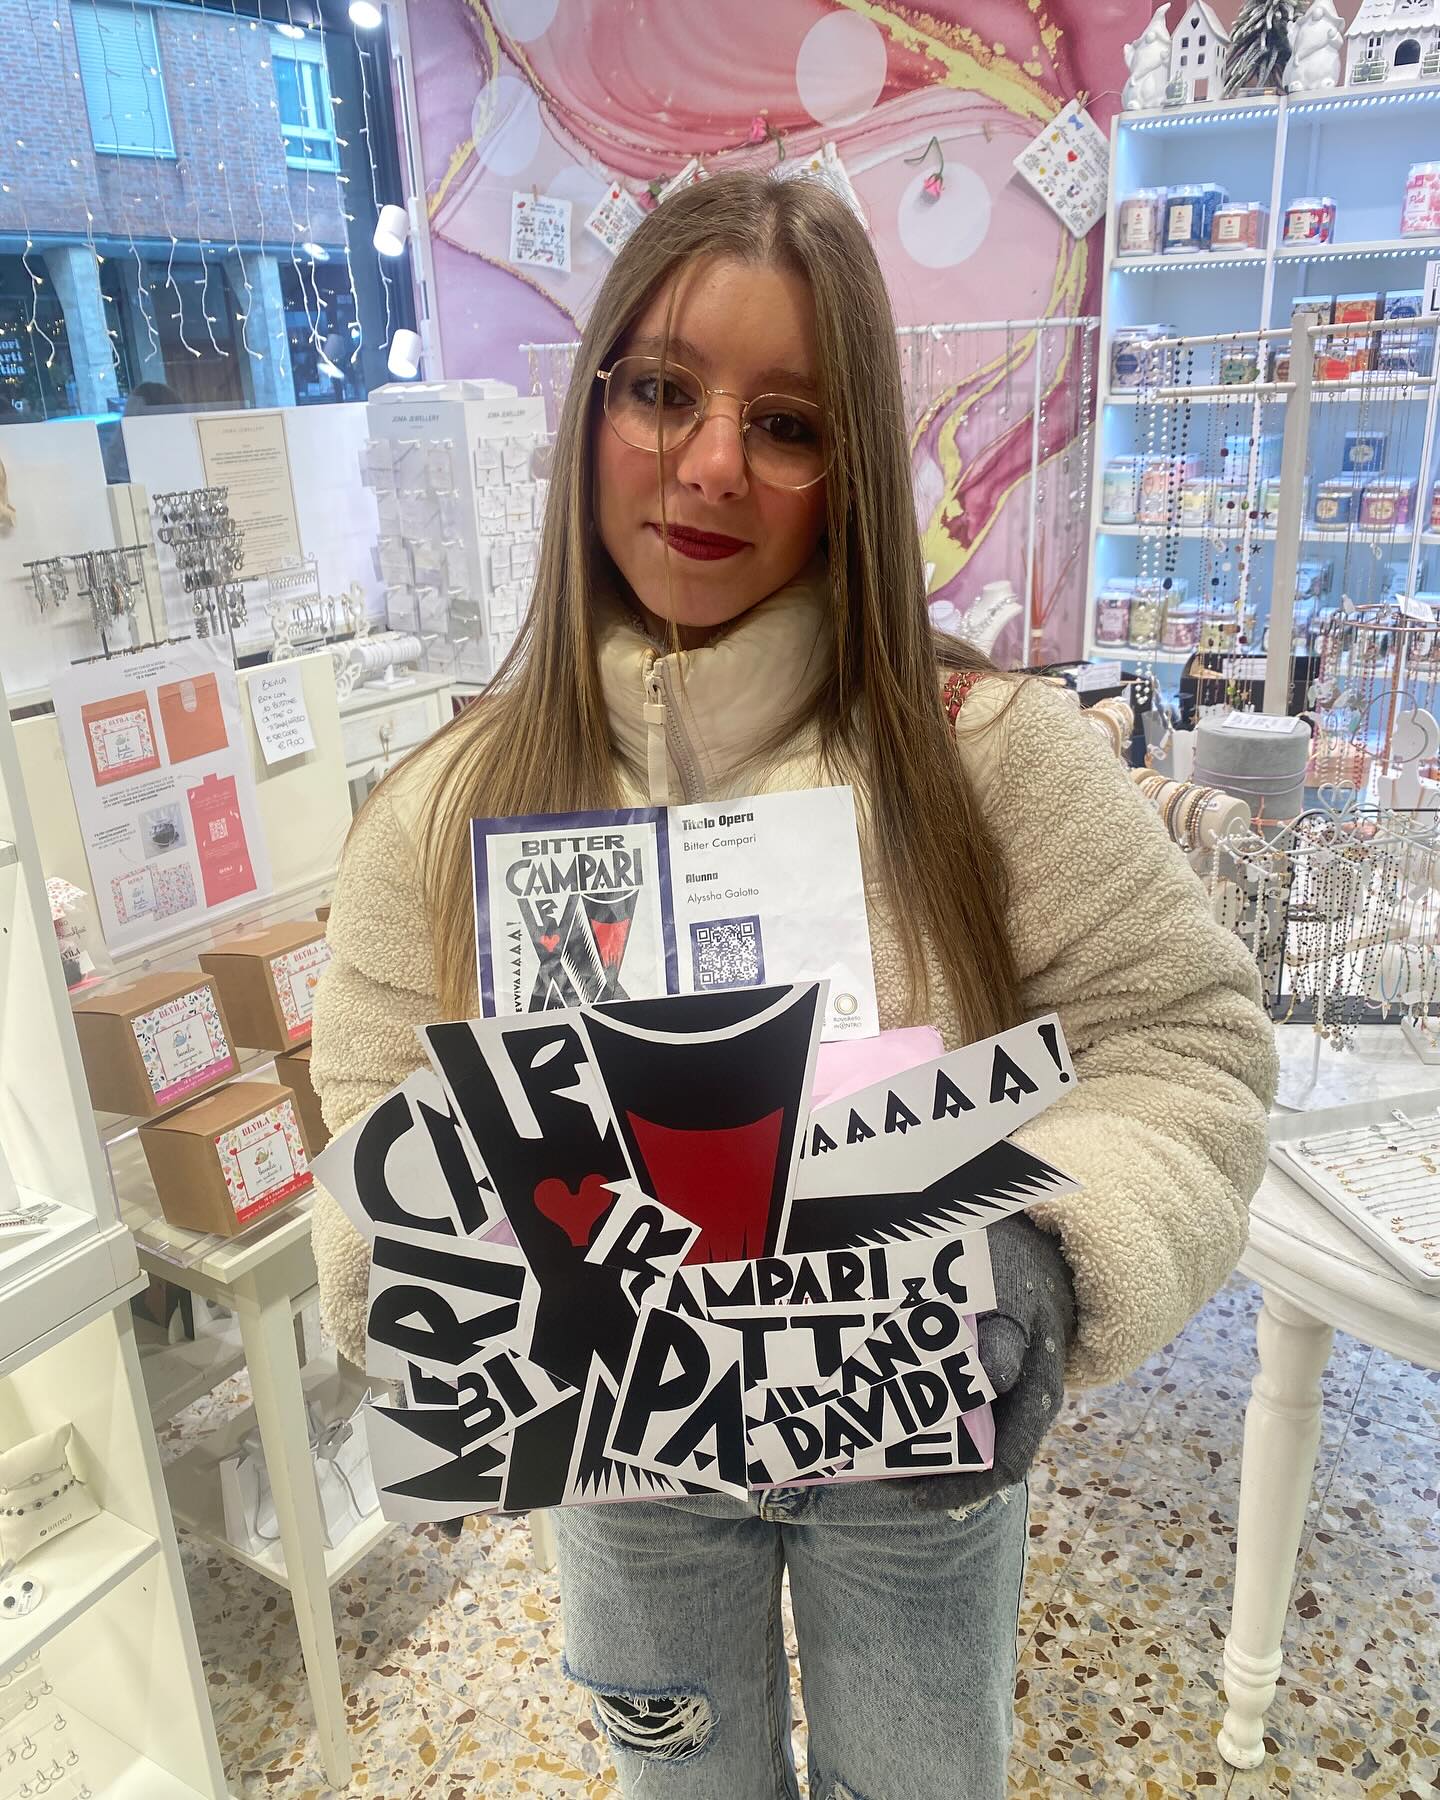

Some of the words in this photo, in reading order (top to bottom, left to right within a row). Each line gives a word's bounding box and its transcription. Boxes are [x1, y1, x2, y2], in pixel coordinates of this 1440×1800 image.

[682, 818, 716, 831] Titolo
[718, 812, 754, 827] Opera
[521, 834, 625, 857] BITTER
[684, 842, 709, 852] Bitter
[712, 833, 757, 848] Campari
[505, 848, 644, 896] CAMPARI
[687, 890, 722, 905] Alyssha
[725, 887, 760, 899] Galotto
[293, 947, 318, 962] BEVILA
[158, 1001, 187, 1019] BEVILA
[241, 1117, 270, 1137] BEVILA
[774, 1350, 987, 1471] DAVIDE
